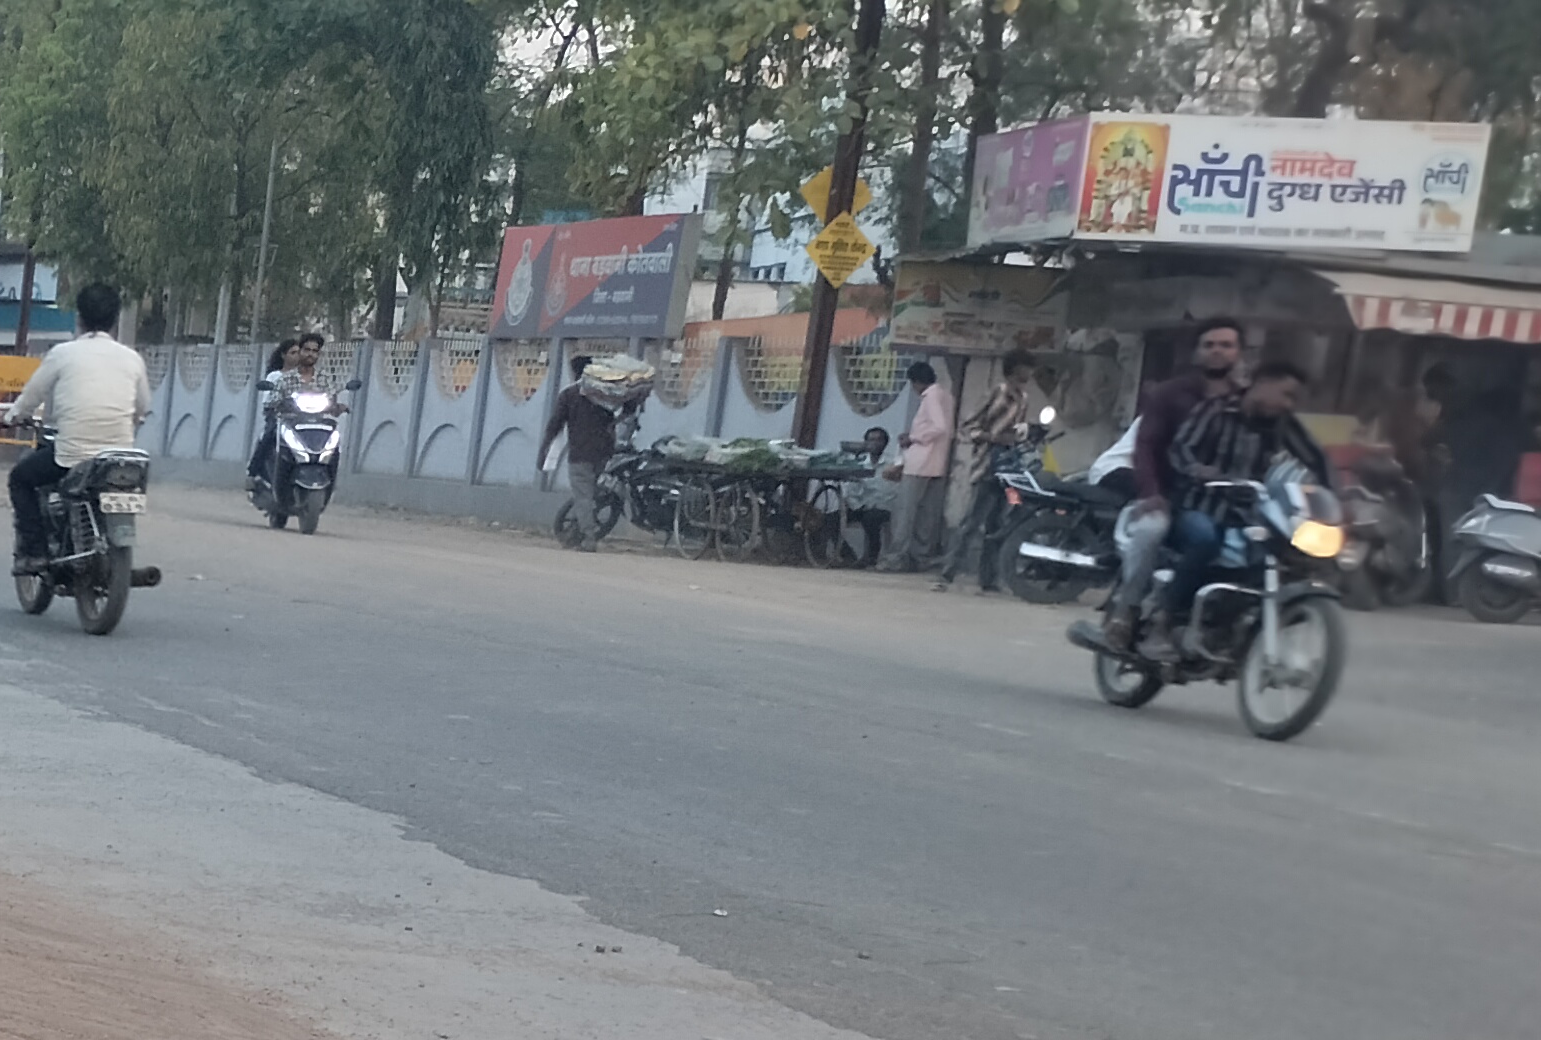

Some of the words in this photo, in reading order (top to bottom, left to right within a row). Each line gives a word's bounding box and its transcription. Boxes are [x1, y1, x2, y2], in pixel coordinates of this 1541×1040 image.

[1270, 152, 1356, 179] नामदेव
[1267, 182, 1323, 212] दुग्ध
[1329, 178, 1406, 205] एजेंसी
